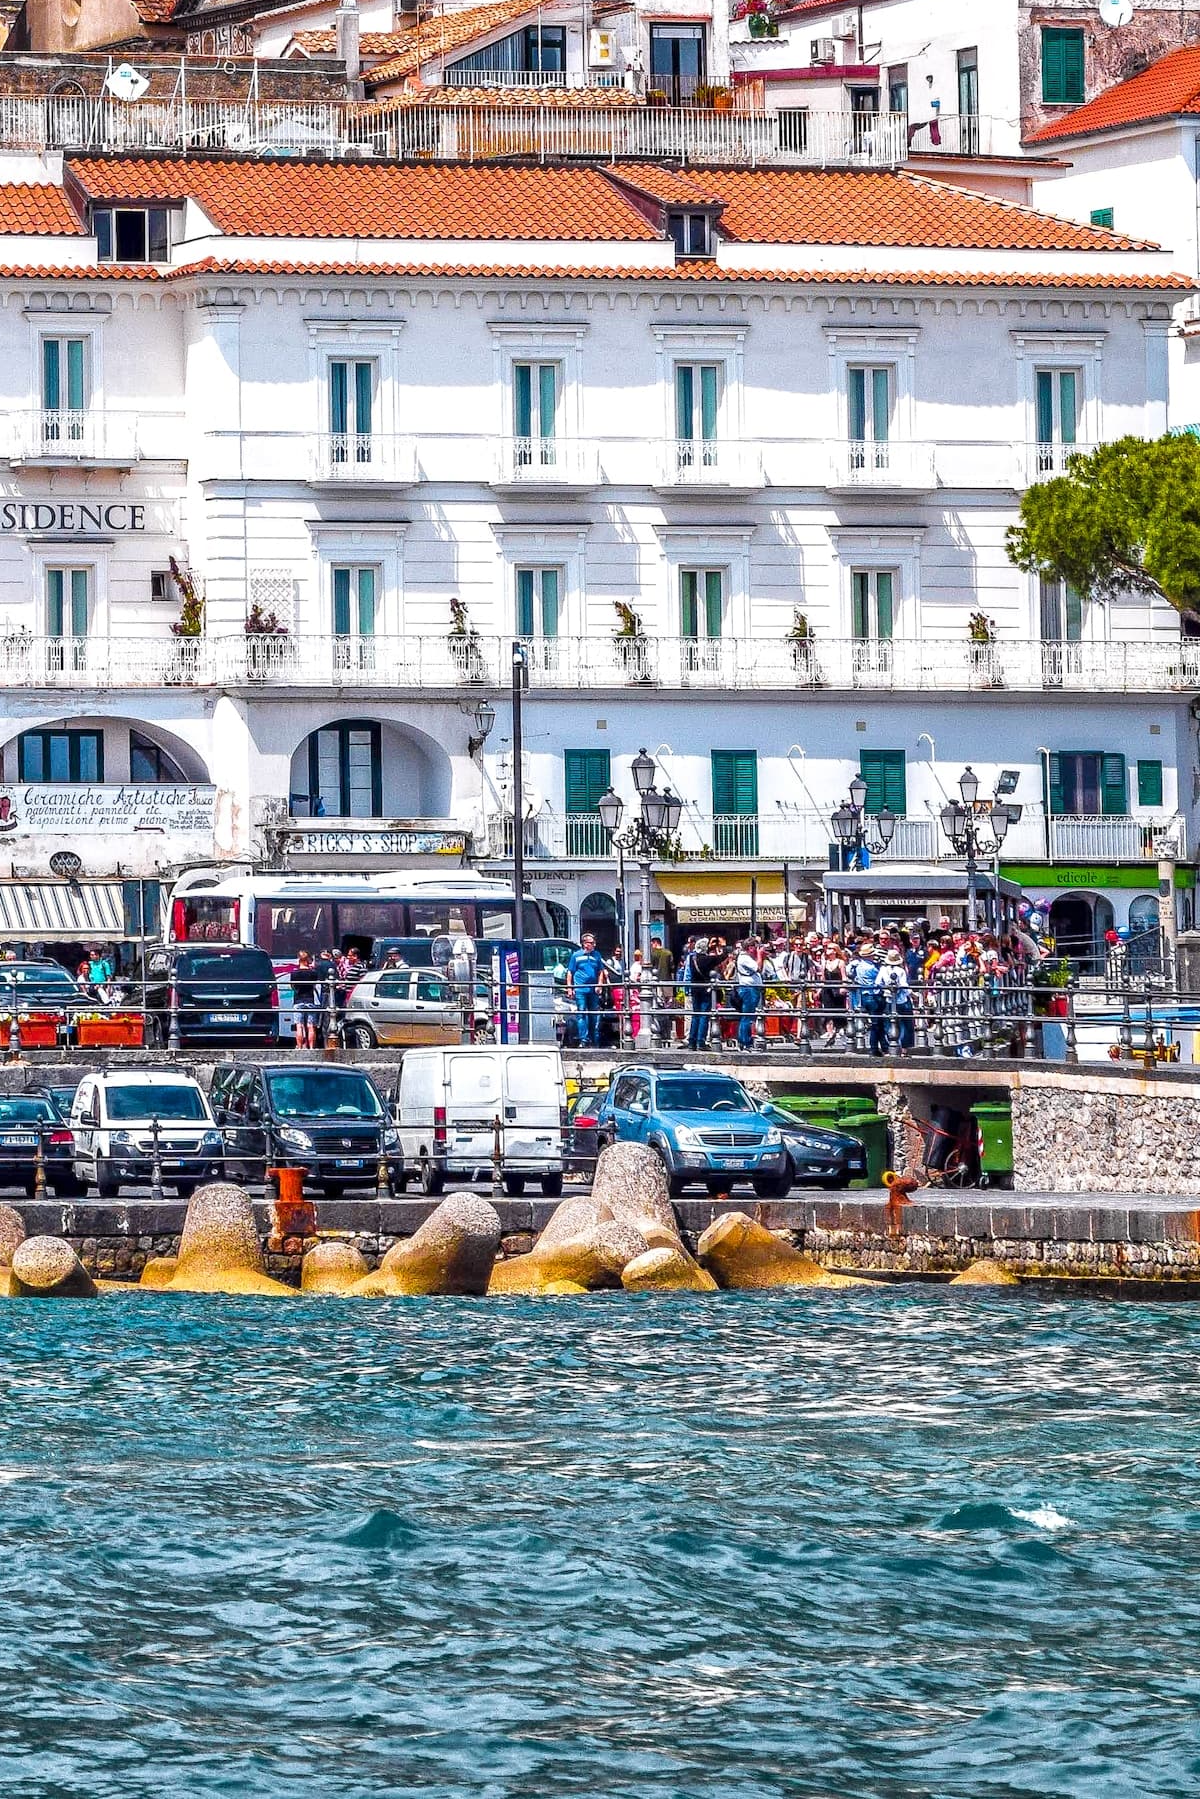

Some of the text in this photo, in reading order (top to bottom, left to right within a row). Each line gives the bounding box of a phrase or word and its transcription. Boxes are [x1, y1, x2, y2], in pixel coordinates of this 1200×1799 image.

[24, 787, 104, 806] Ceramiche
[113, 787, 186, 806] Artistiche
[92, 804, 137, 817] pannelli
[29, 816, 94, 828] Esposizione
[99, 816, 128, 827] primo
[139, 816, 168, 827] piano
[307, 833, 417, 853] RICKY'S SHOP
[518, 871, 575, 880] ESIDENCE
[690, 908, 727, 917] GELATO
